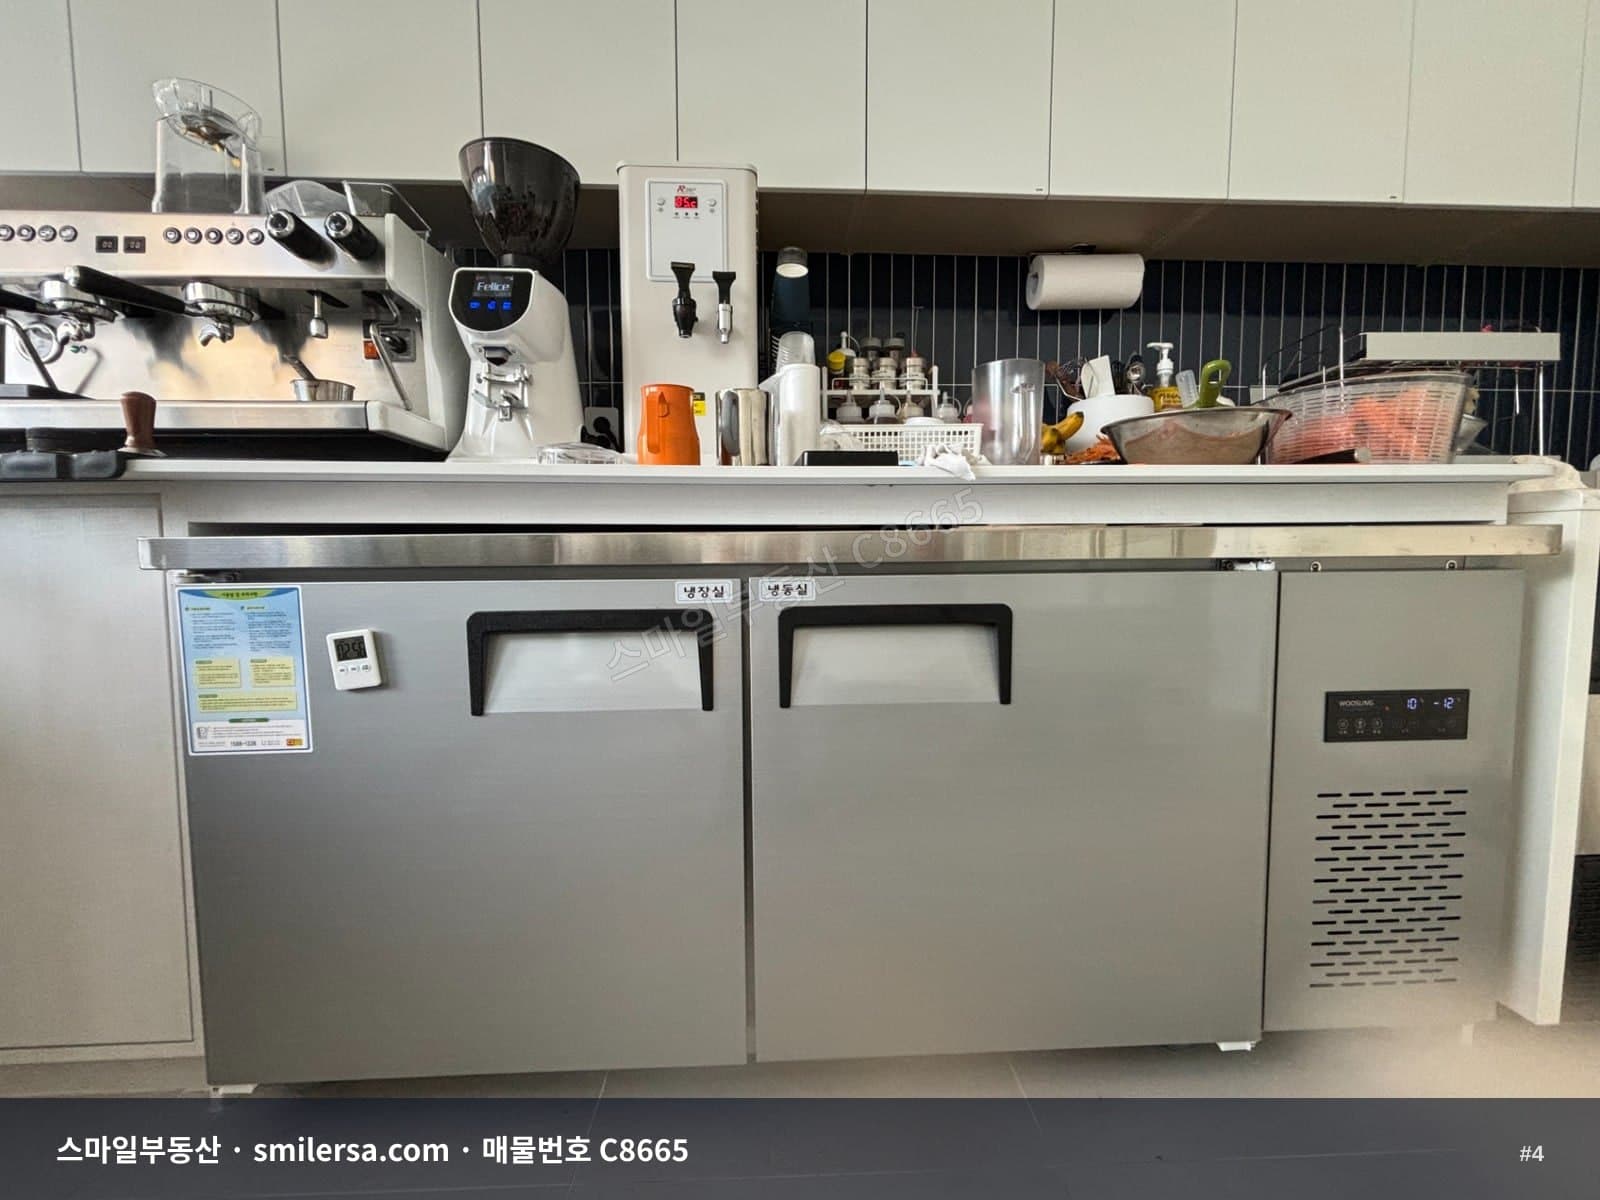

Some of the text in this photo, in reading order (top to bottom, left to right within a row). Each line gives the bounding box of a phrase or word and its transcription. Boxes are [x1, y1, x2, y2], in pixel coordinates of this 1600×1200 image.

[476, 282, 511, 291] Felice
[684, 585, 724, 599] 냉장실
[768, 583, 807, 597] 냉동실
[1407, 697, 1417, 709] 10
